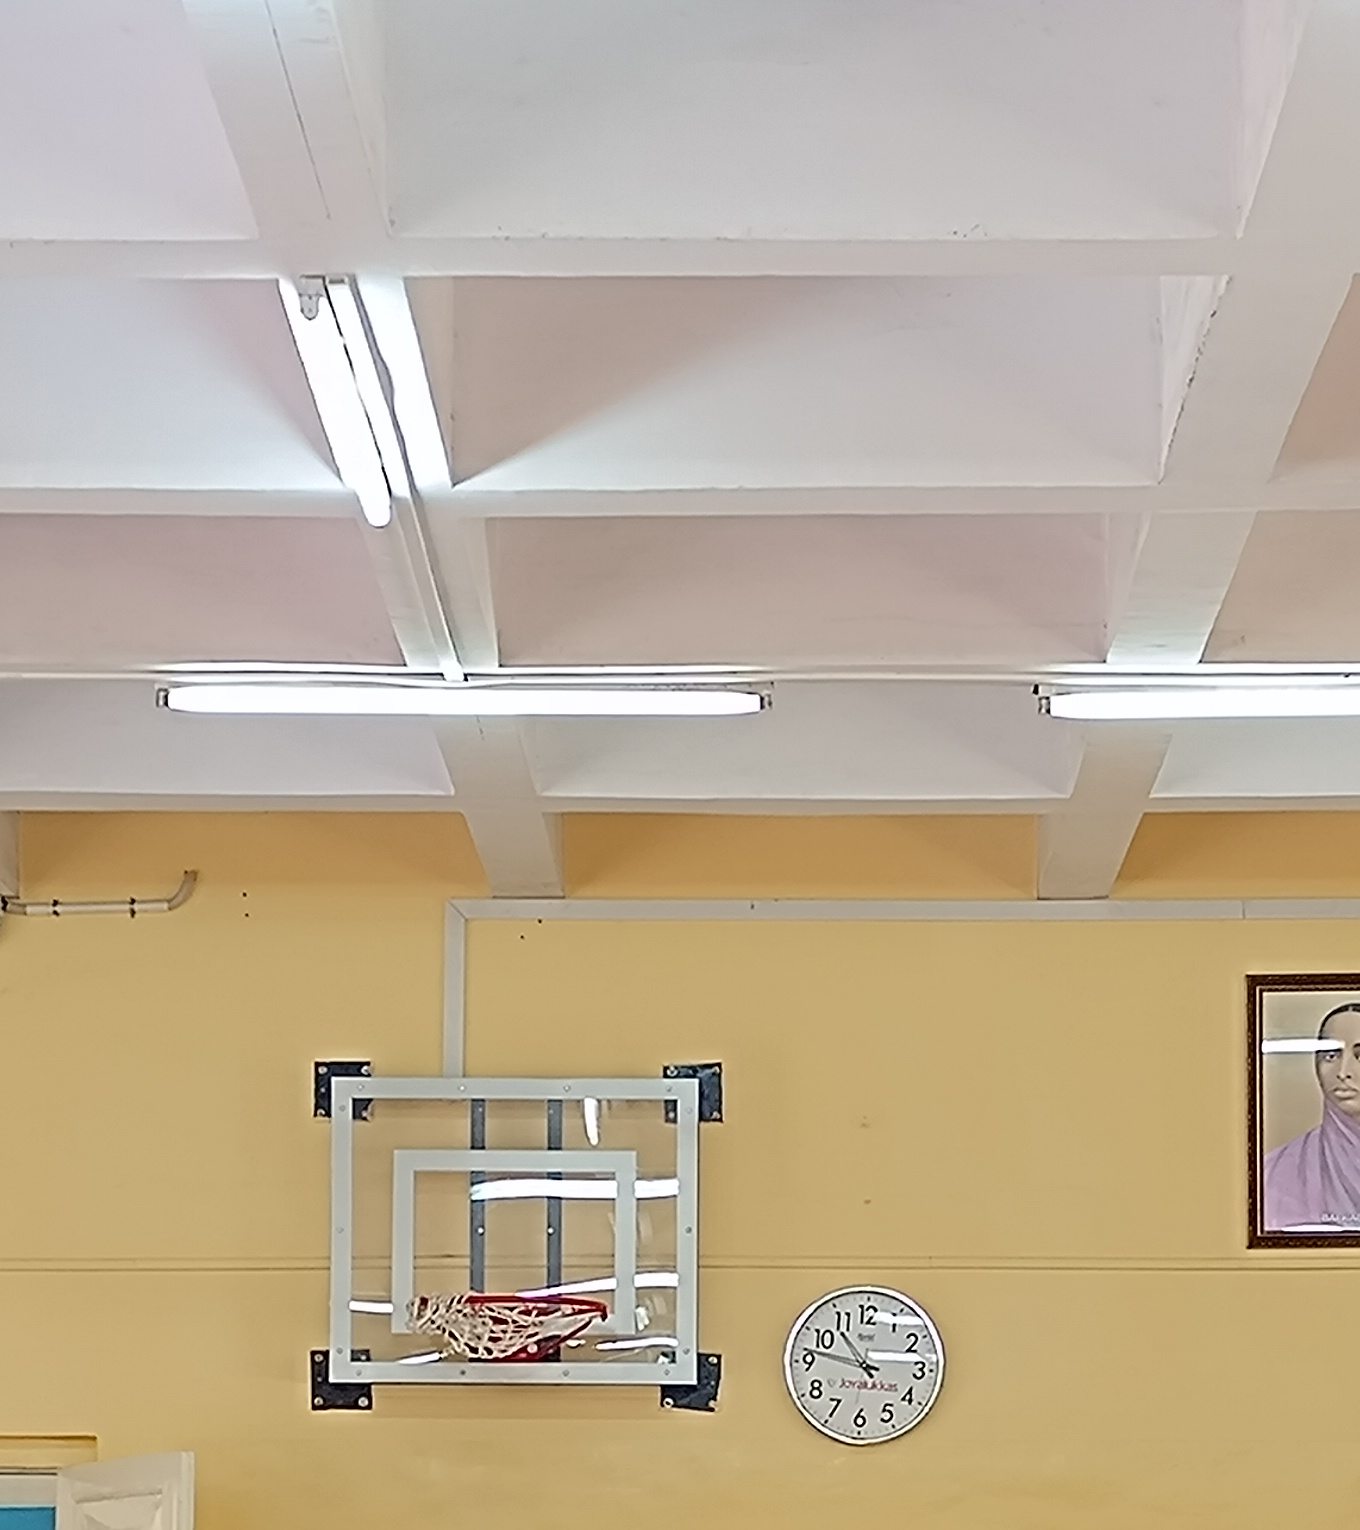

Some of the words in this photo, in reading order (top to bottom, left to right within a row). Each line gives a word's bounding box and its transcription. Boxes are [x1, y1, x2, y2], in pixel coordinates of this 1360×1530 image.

[835, 1311, 851, 1332] 11
[858, 1304, 878, 1325] 12
[815, 1328, 835, 1350] 10
[906, 1332, 919, 1353] 2
[802, 1352, 815, 1372] 9
[912, 1361, 926, 1380] 3
[809, 1379, 823, 1399] 8
[900, 1386, 914, 1405] 4
[829, 1397, 843, 1418] 7
[853, 1408, 867, 1428] 6
[880, 1403, 894, 1424] 5
